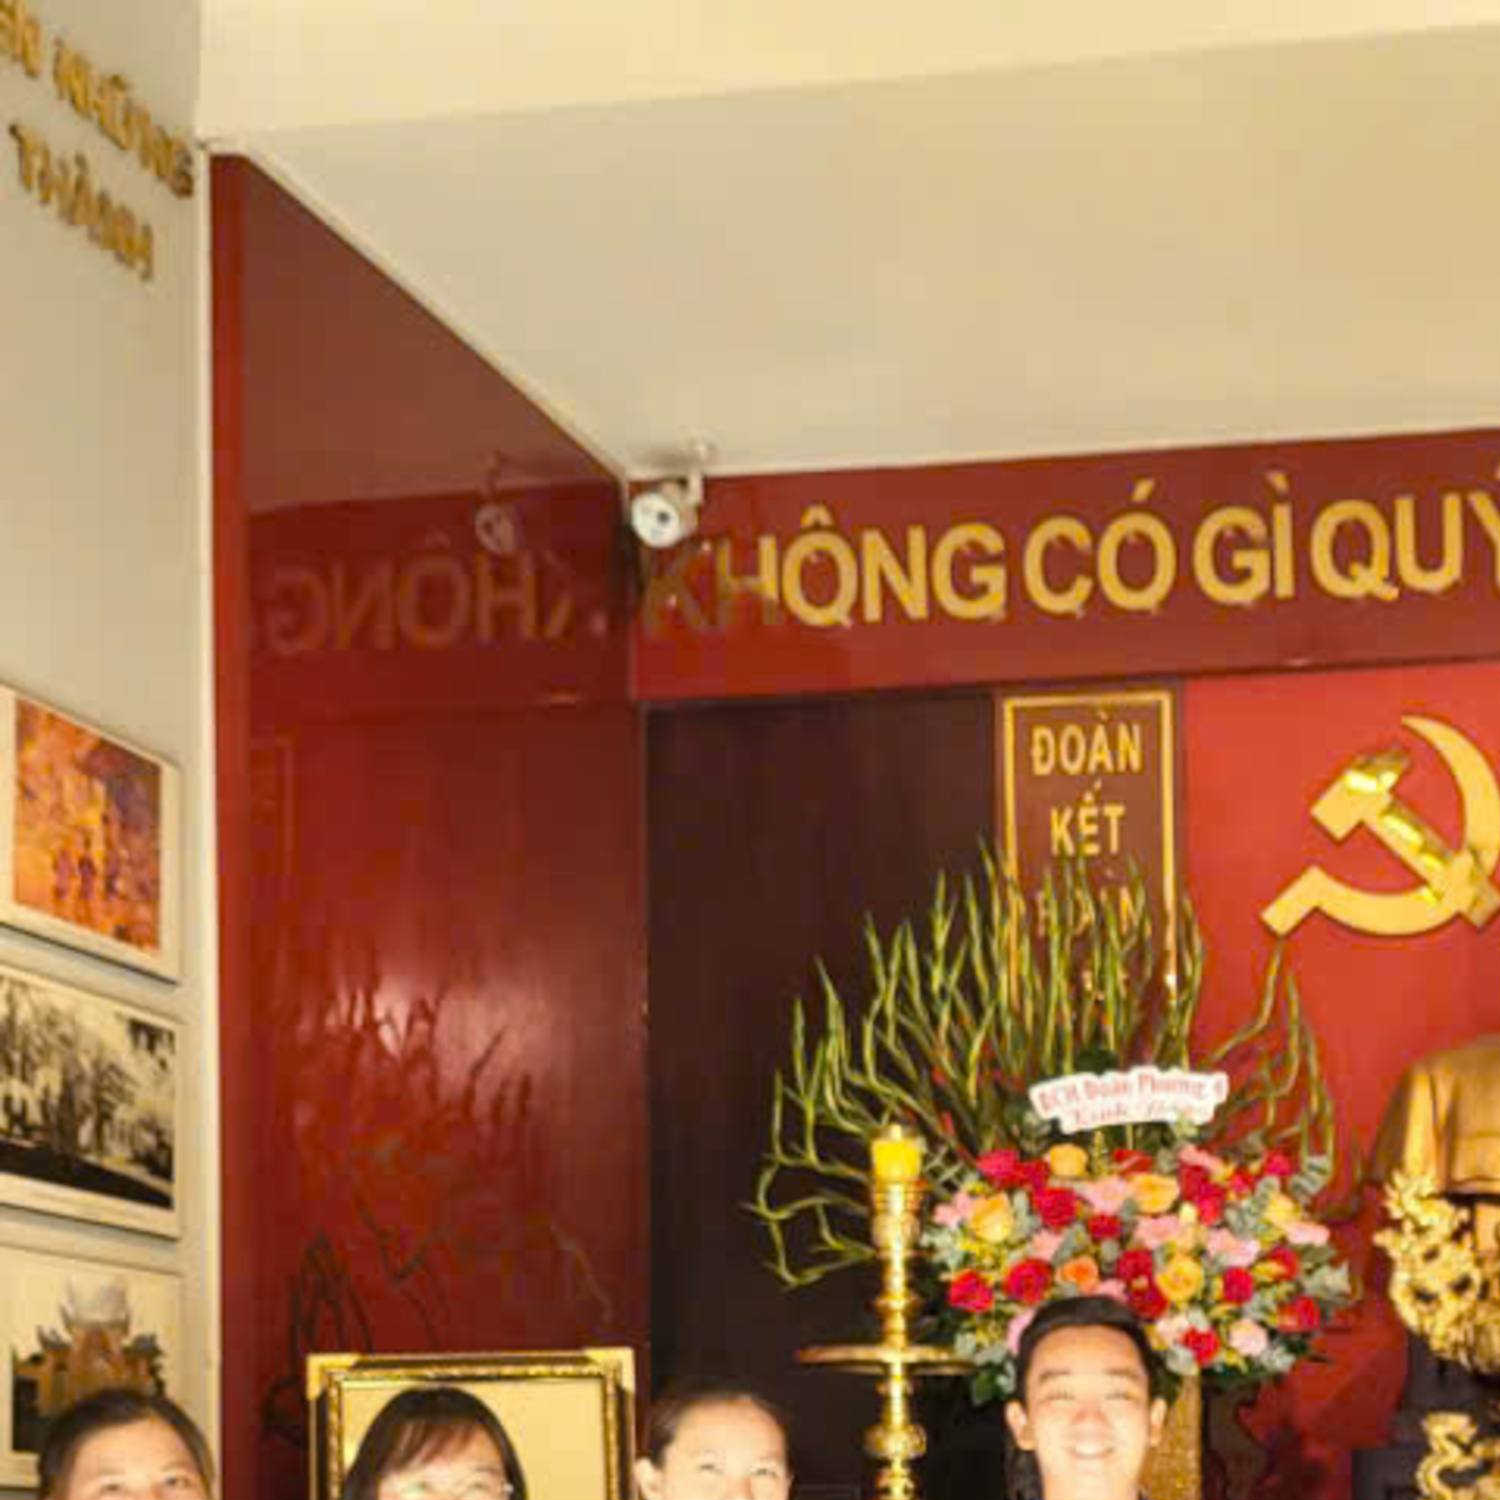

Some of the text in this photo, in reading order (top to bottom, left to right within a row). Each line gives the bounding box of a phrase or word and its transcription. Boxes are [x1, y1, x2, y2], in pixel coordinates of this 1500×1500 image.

[640, 502, 1005, 640] KHÔNG
[1023, 478, 1177, 620] CÓ
[1192, 471, 1295, 606] GÌ
[1029, 708, 1144, 778] ĐOÀN
[1049, 778, 1127, 856] KẾT
